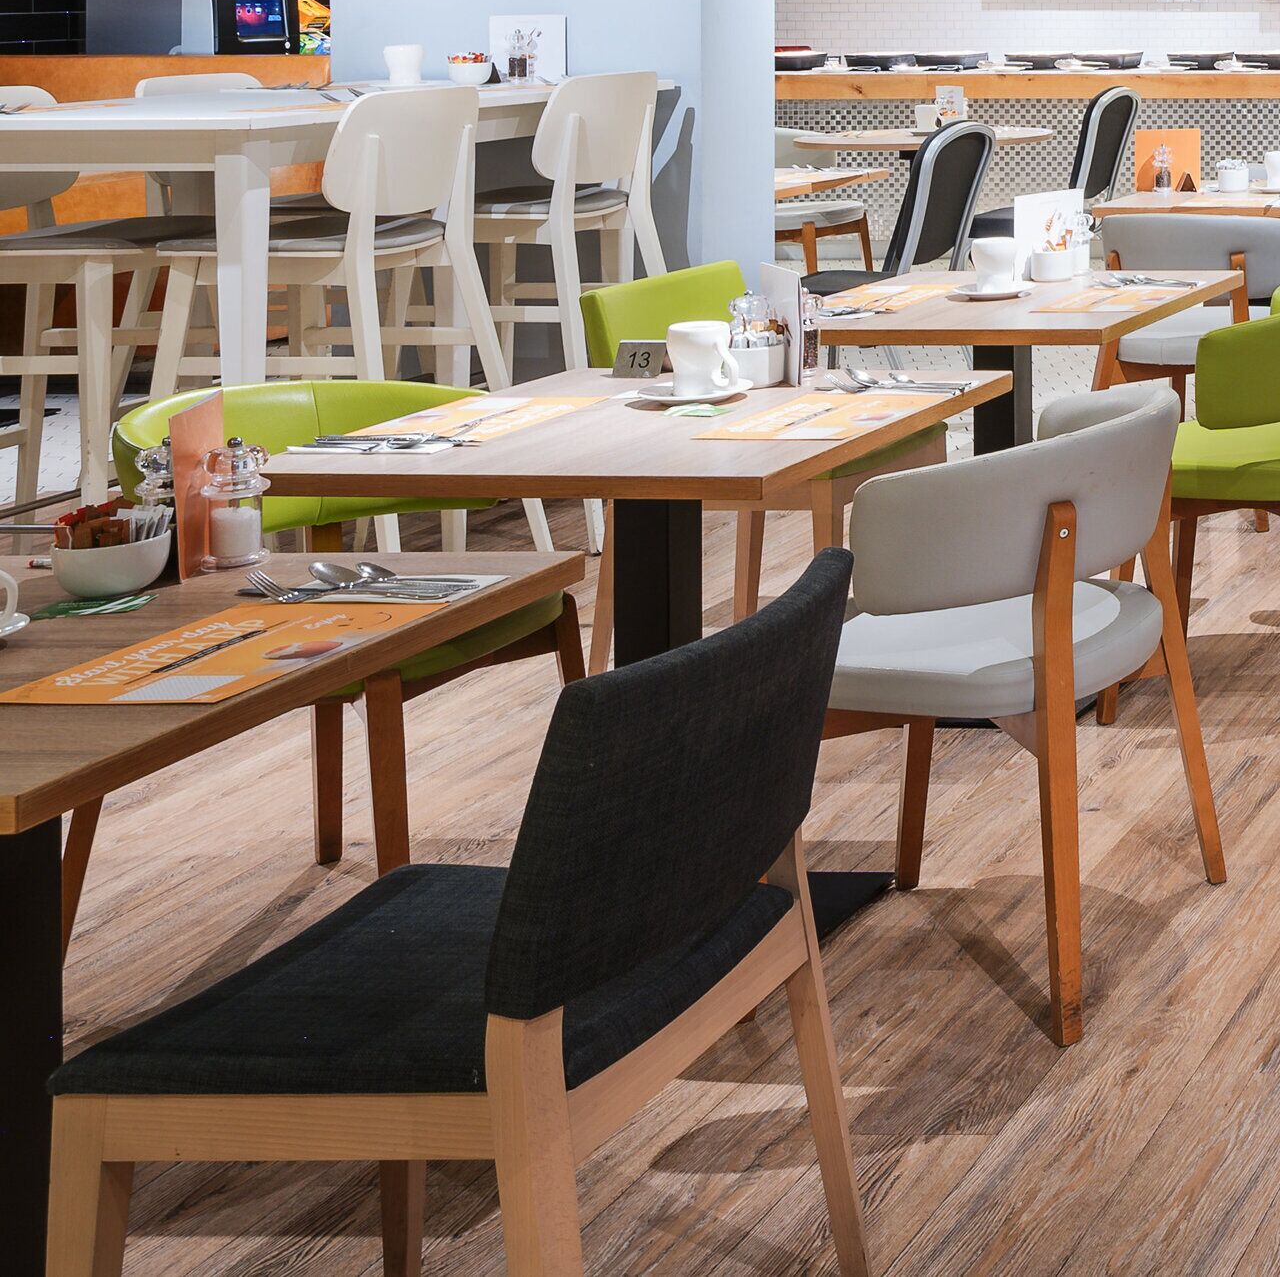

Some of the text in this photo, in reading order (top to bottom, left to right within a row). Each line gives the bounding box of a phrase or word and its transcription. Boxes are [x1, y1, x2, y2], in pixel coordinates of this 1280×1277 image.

[629, 351, 651, 369] 13
[55, 660, 127, 686] Start
[124, 638, 184, 663] your
[183, 621, 232, 640] day
[80, 652, 185, 686] WITH
[186, 641, 211, 653] A
